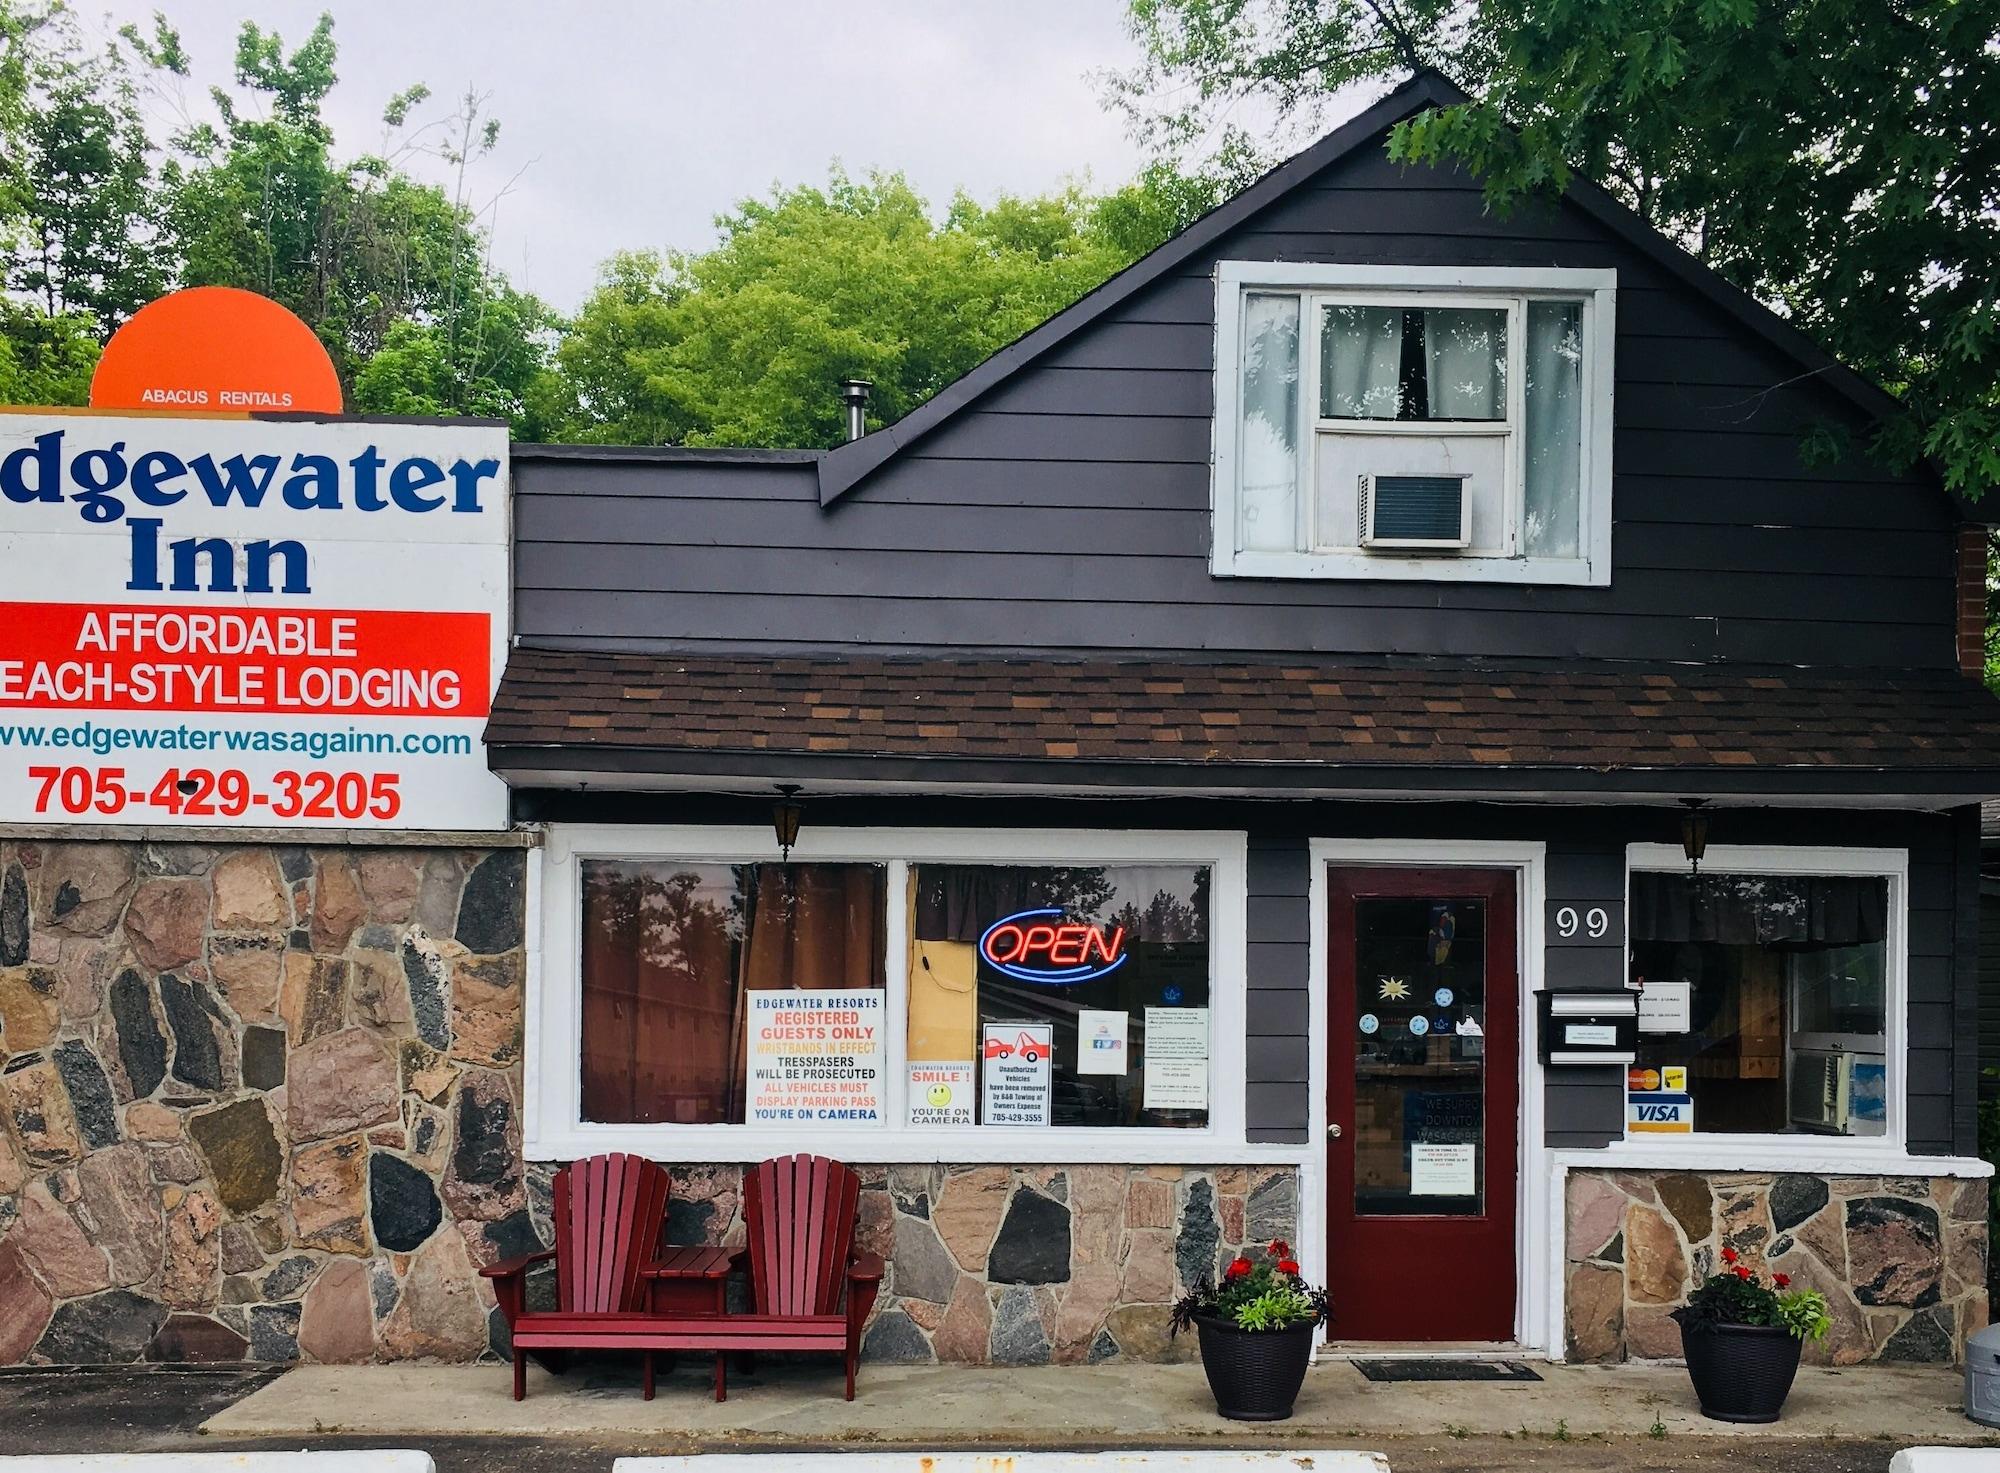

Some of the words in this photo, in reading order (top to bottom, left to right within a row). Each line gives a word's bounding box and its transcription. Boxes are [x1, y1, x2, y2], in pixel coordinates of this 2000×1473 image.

[142, 389, 208, 404] ABACUS
[219, 391, 293, 407] RENTALS
[0, 429, 501, 523] dgewater
[126, 517, 311, 594] Inn
[75, 612, 358, 658] AFFORDABLE
[0, 659, 265, 706] EACH-STYLE
[276, 666, 462, 709] LODGING
[28, 765, 401, 820] 705-429-3205
[1556, 907, 1608, 938] 99
[986, 924, 1124, 963] OPEN
[756, 998, 823, 1009] EDGEWATER
[828, 998, 878, 1009] RESORTS
[775, 1011, 859, 1025] REGISTERED
[761, 1027, 826, 1040] GUESTS
[831, 1027, 874, 1040] ONLY
[757, 1042, 821, 1054] WRISTBANDS
[826, 1042, 836, 1054] IN
[840, 1042, 877, 1054] EFFECT
[778, 1056, 854, 1067] TRESSPASERS
[756, 1069, 782, 1079] WILL
[786, 1069, 800, 1079] BE
[803, 1069, 876, 1079] PROSECUTED
[912, 1071, 960, 1082] SMILE
[765, 1083, 784, 1093] ALL
[787, 1083, 837, 1093] VEHICLES
[840, 1083, 868, 1093] MUST
[1020, 1084, 1046, 1092] removed
[756, 1096, 799, 1107] DISPLAY
[802, 1096, 847, 1107] PARKING
[851, 1096, 876, 1107] PASS
[993, 1093, 1001, 1101] by
[1014, 1093, 1035, 1101] Towing
[994, 1102, 1016, 1110] Owners
[1017, 1102, 1041, 1110] Expense
[755, 1109, 794, 1119] YOU'RE
[797, 1109, 813, 1119] ON
[818, 1109, 877, 1119] CAMERA
[912, 1108, 951, 1116] YOU'RE
[954, 1108, 970, 1116] ON
[992, 1113, 1042, 1122] 705-429-3555
[1637, 1105, 1679, 1121] VISA
[912, 1116, 970, 1124] CAMERA
